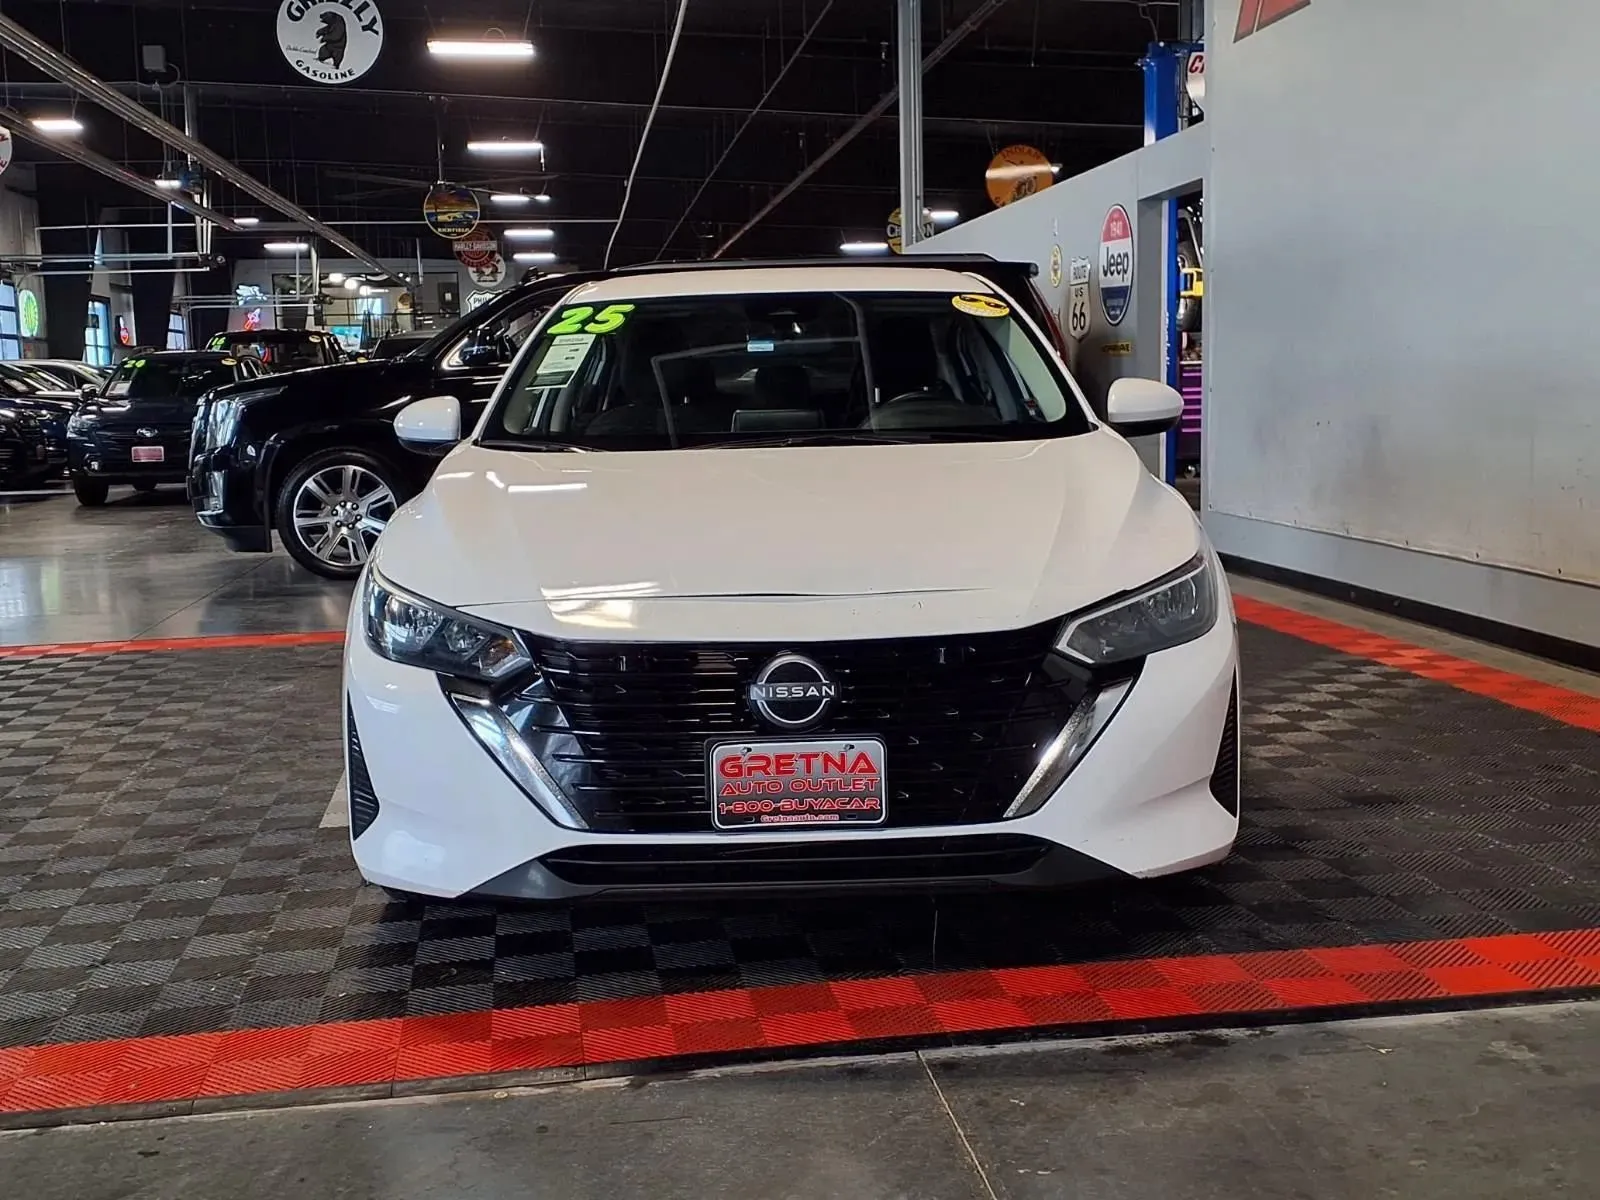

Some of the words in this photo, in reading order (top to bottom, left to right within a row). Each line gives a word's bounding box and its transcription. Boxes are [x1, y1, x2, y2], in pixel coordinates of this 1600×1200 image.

[295, 59, 356, 80] GASOLINE
[1102, 247, 1129, 282] Jeep
[1074, 287, 1084, 297] US
[546, 303, 636, 335] 25
[1071, 302, 1087, 330] 66
[751, 685, 835, 698] NISSAN
[720, 752, 878, 779] GRETNA
[720, 781, 783, 796] AUTO
[790, 778, 880, 792] OUTLET
[719, 798, 880, 814] 1-800-BUYACAR
